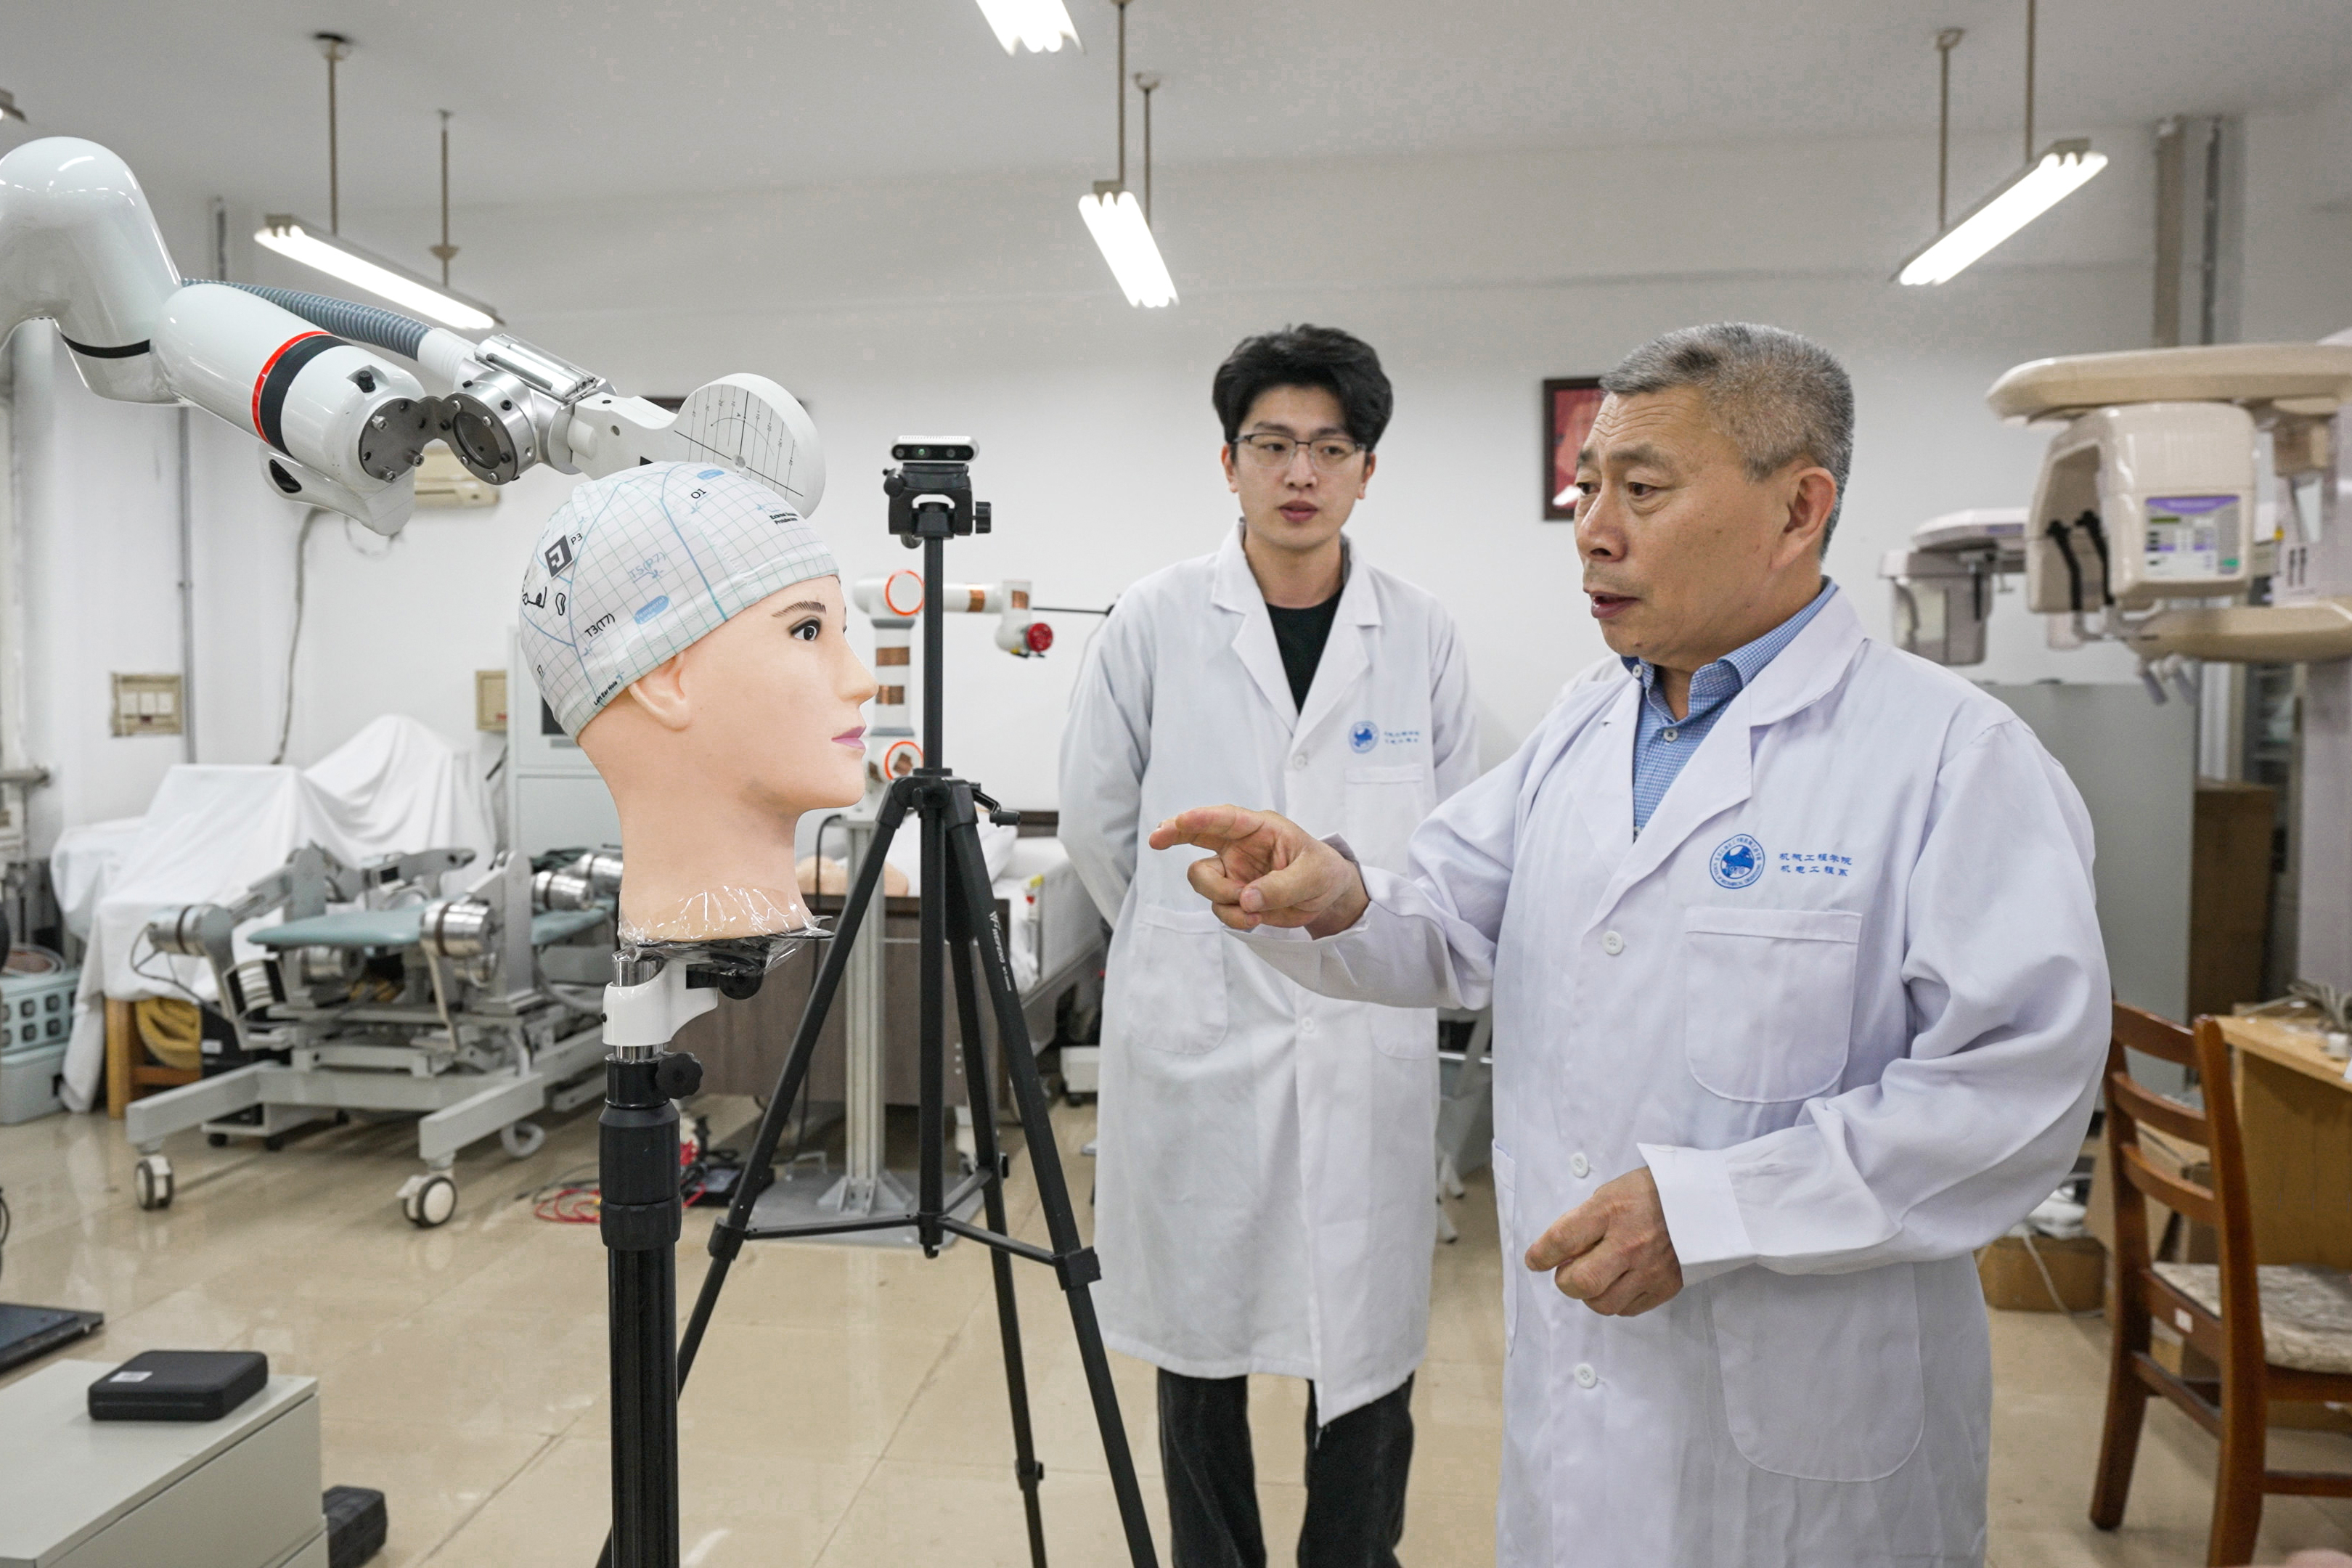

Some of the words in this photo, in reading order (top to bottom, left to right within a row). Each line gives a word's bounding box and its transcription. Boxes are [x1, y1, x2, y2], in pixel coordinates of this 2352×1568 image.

[691, 489, 706, 499] O1
[571, 533, 583, 545] P3
[630, 552, 666, 578] T5(P7)
[584, 613, 616, 637] T3(T7)
[593, 695, 603, 706] Left
[608, 680, 618, 691] Hole
[992, 928, 1005, 963] WEIFENG
